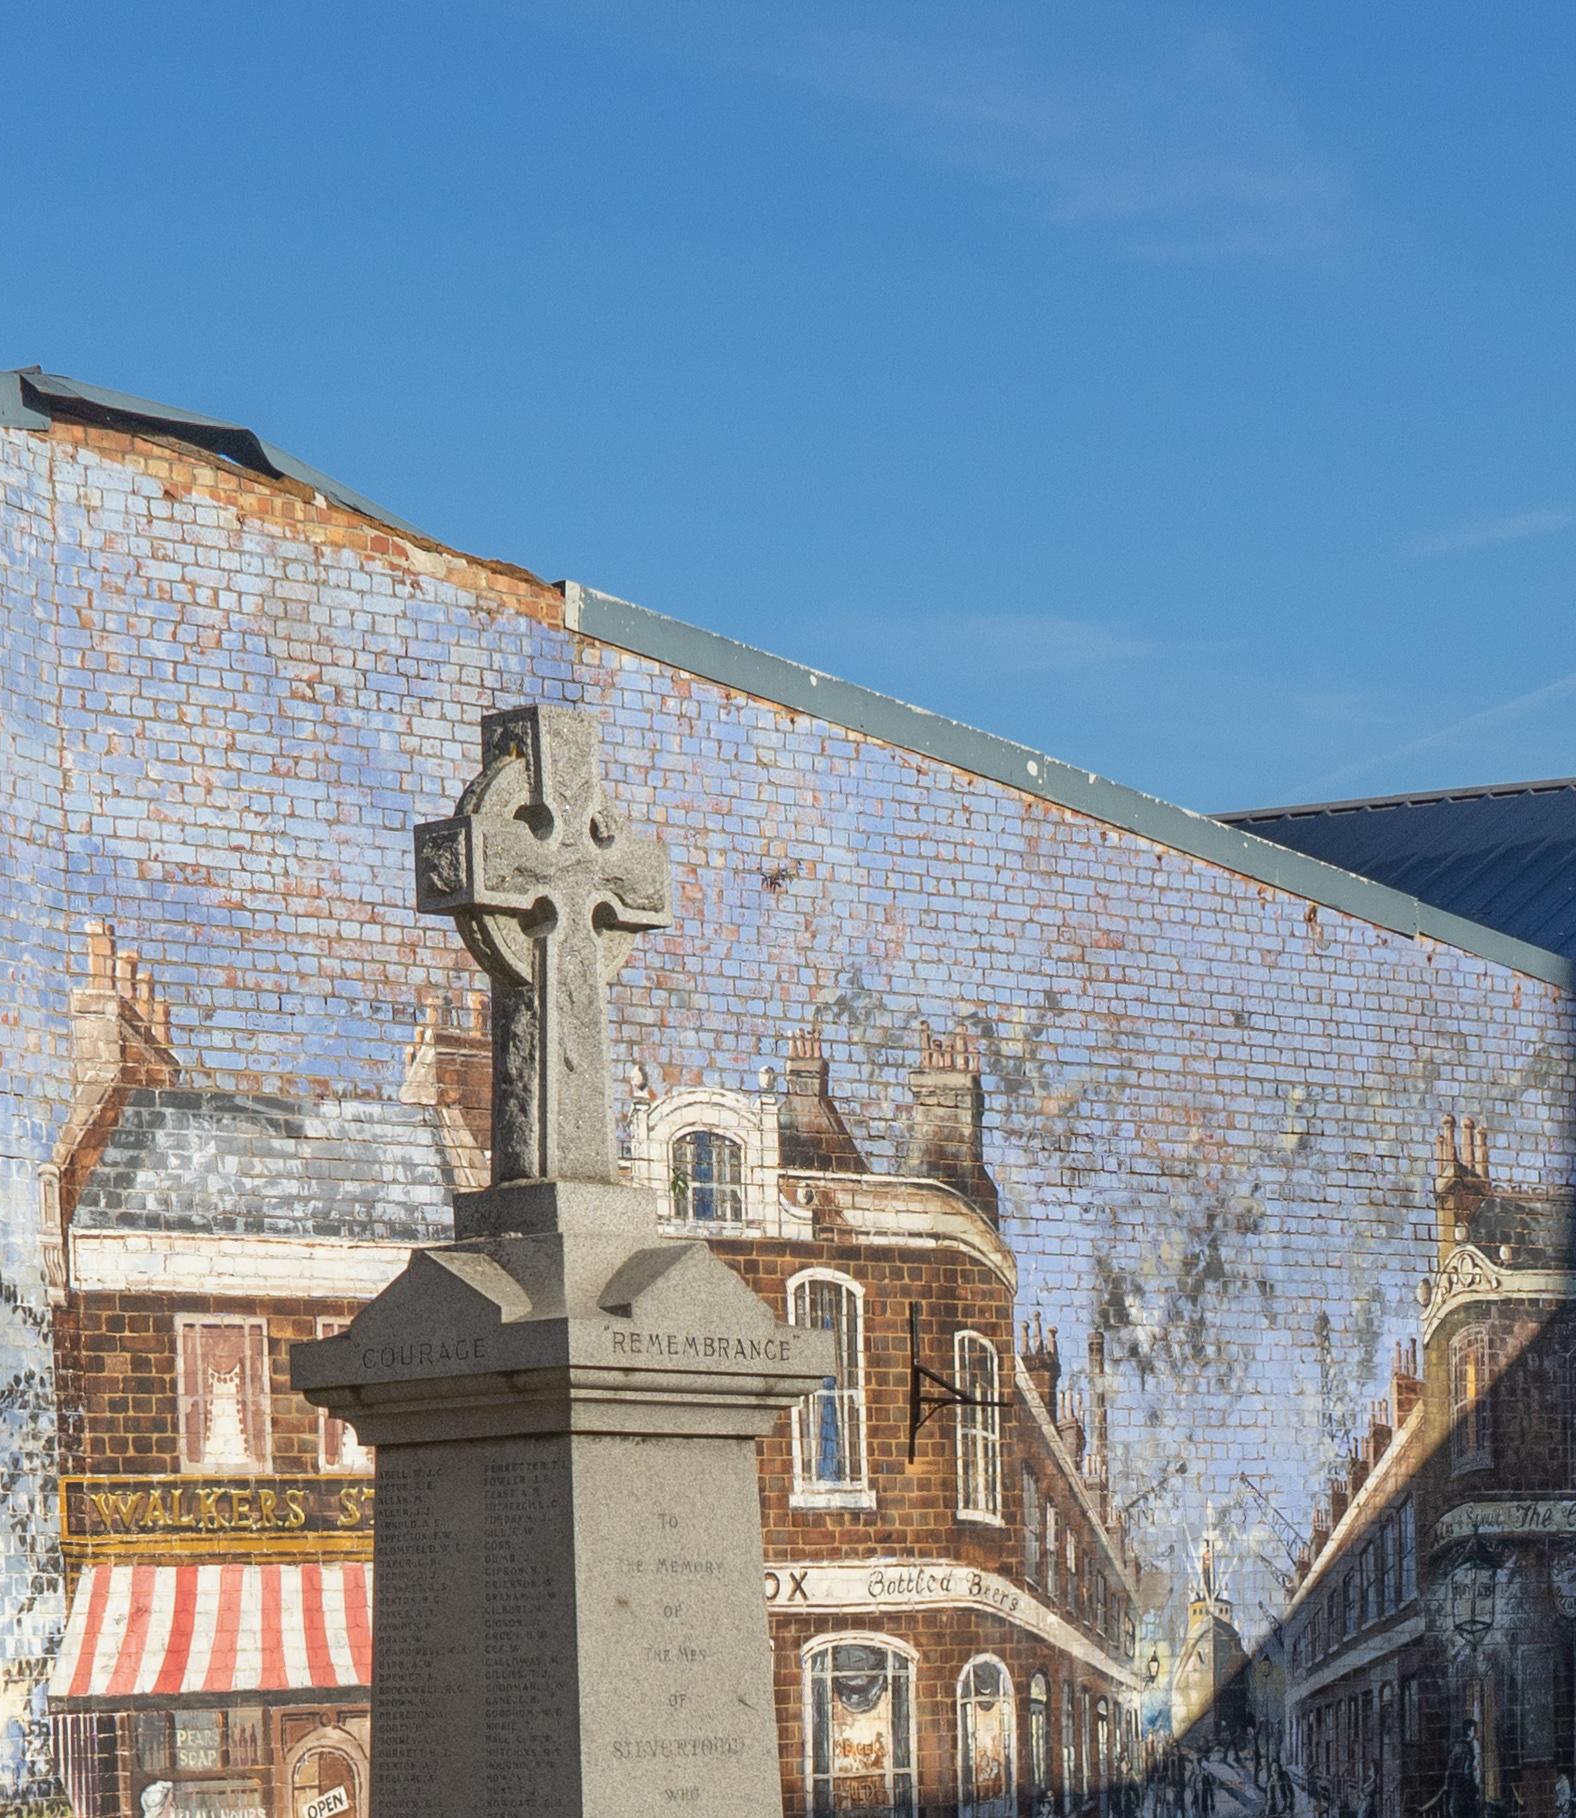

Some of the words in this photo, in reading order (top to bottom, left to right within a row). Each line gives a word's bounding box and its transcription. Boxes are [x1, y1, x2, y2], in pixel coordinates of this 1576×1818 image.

[91, 1488, 309, 1530] WALKERS
[1515, 1503, 1552, 1529] The
[867, 1567, 953, 1599] Bottled
[967, 1571, 1020, 1612] Beers
